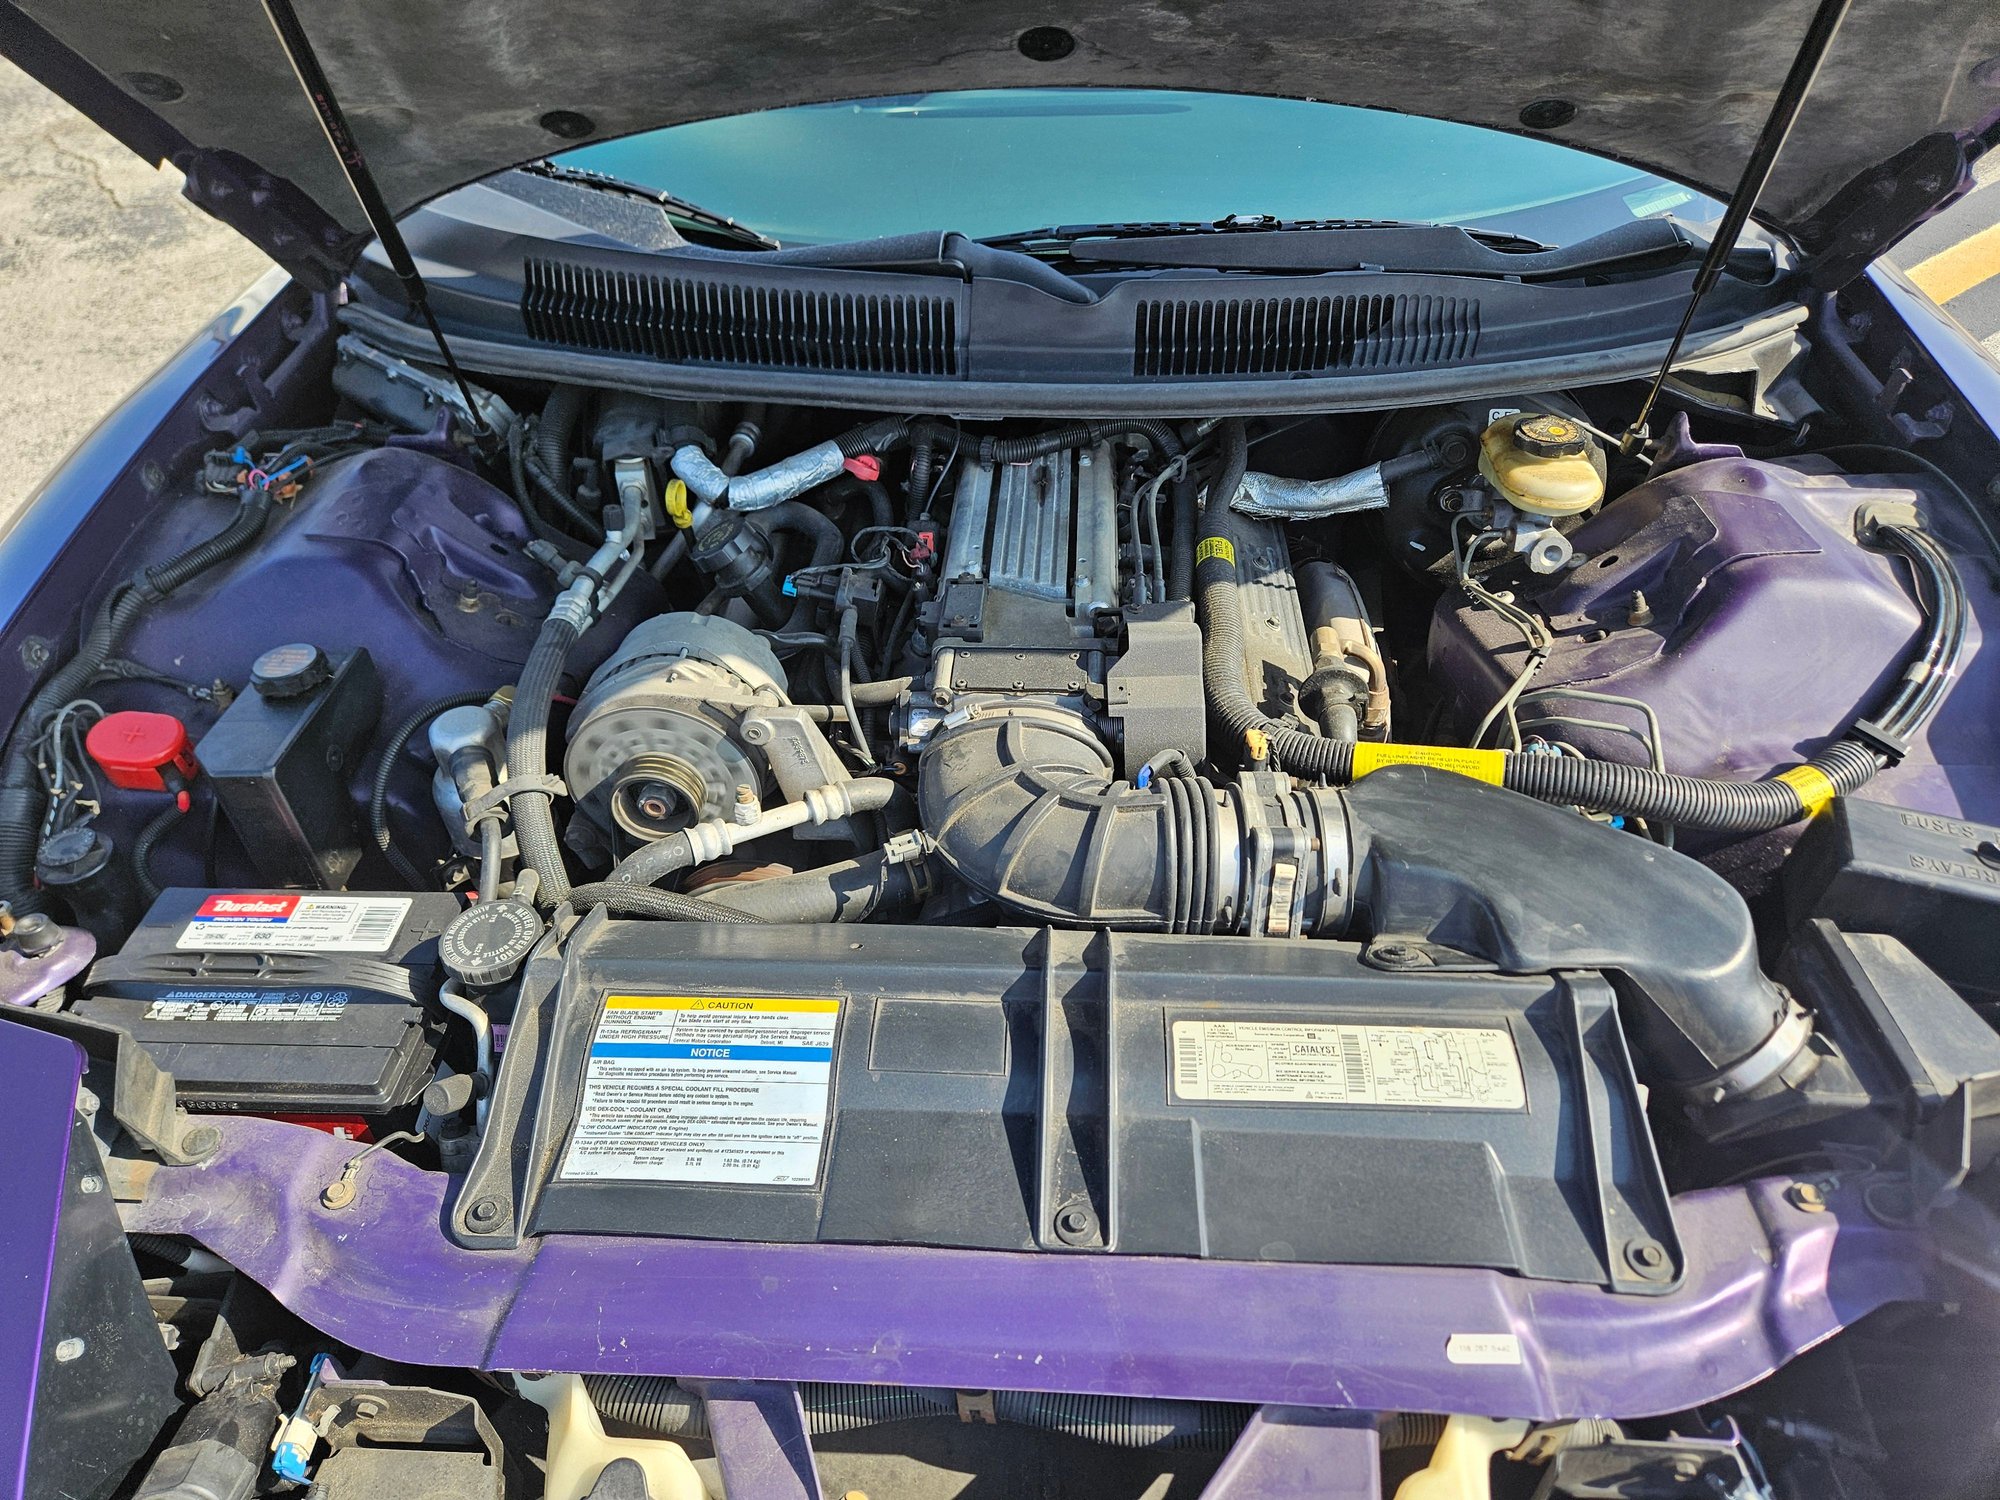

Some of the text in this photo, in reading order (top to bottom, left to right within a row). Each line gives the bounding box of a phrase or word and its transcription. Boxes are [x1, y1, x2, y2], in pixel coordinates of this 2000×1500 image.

[1215, 541, 1223, 555] FUEL
[1902, 813, 1975, 839] FUSES
[1911, 855, 1996, 883] RELAYS
[213, 900, 287, 912] Duralast
[469, 905, 489, 917] ALIGN
[502, 913, 519, 924] CHECK
[495, 908, 533, 963] NEVER OPEN HOT
[513, 923, 522, 939] LEVEL
[483, 945, 509, 957] BOTTLE
[707, 1001, 754, 1009] CAUTION
[690, 1048, 730, 1057] NOTICE
[1294, 1045, 1336, 1053] CATALYST
